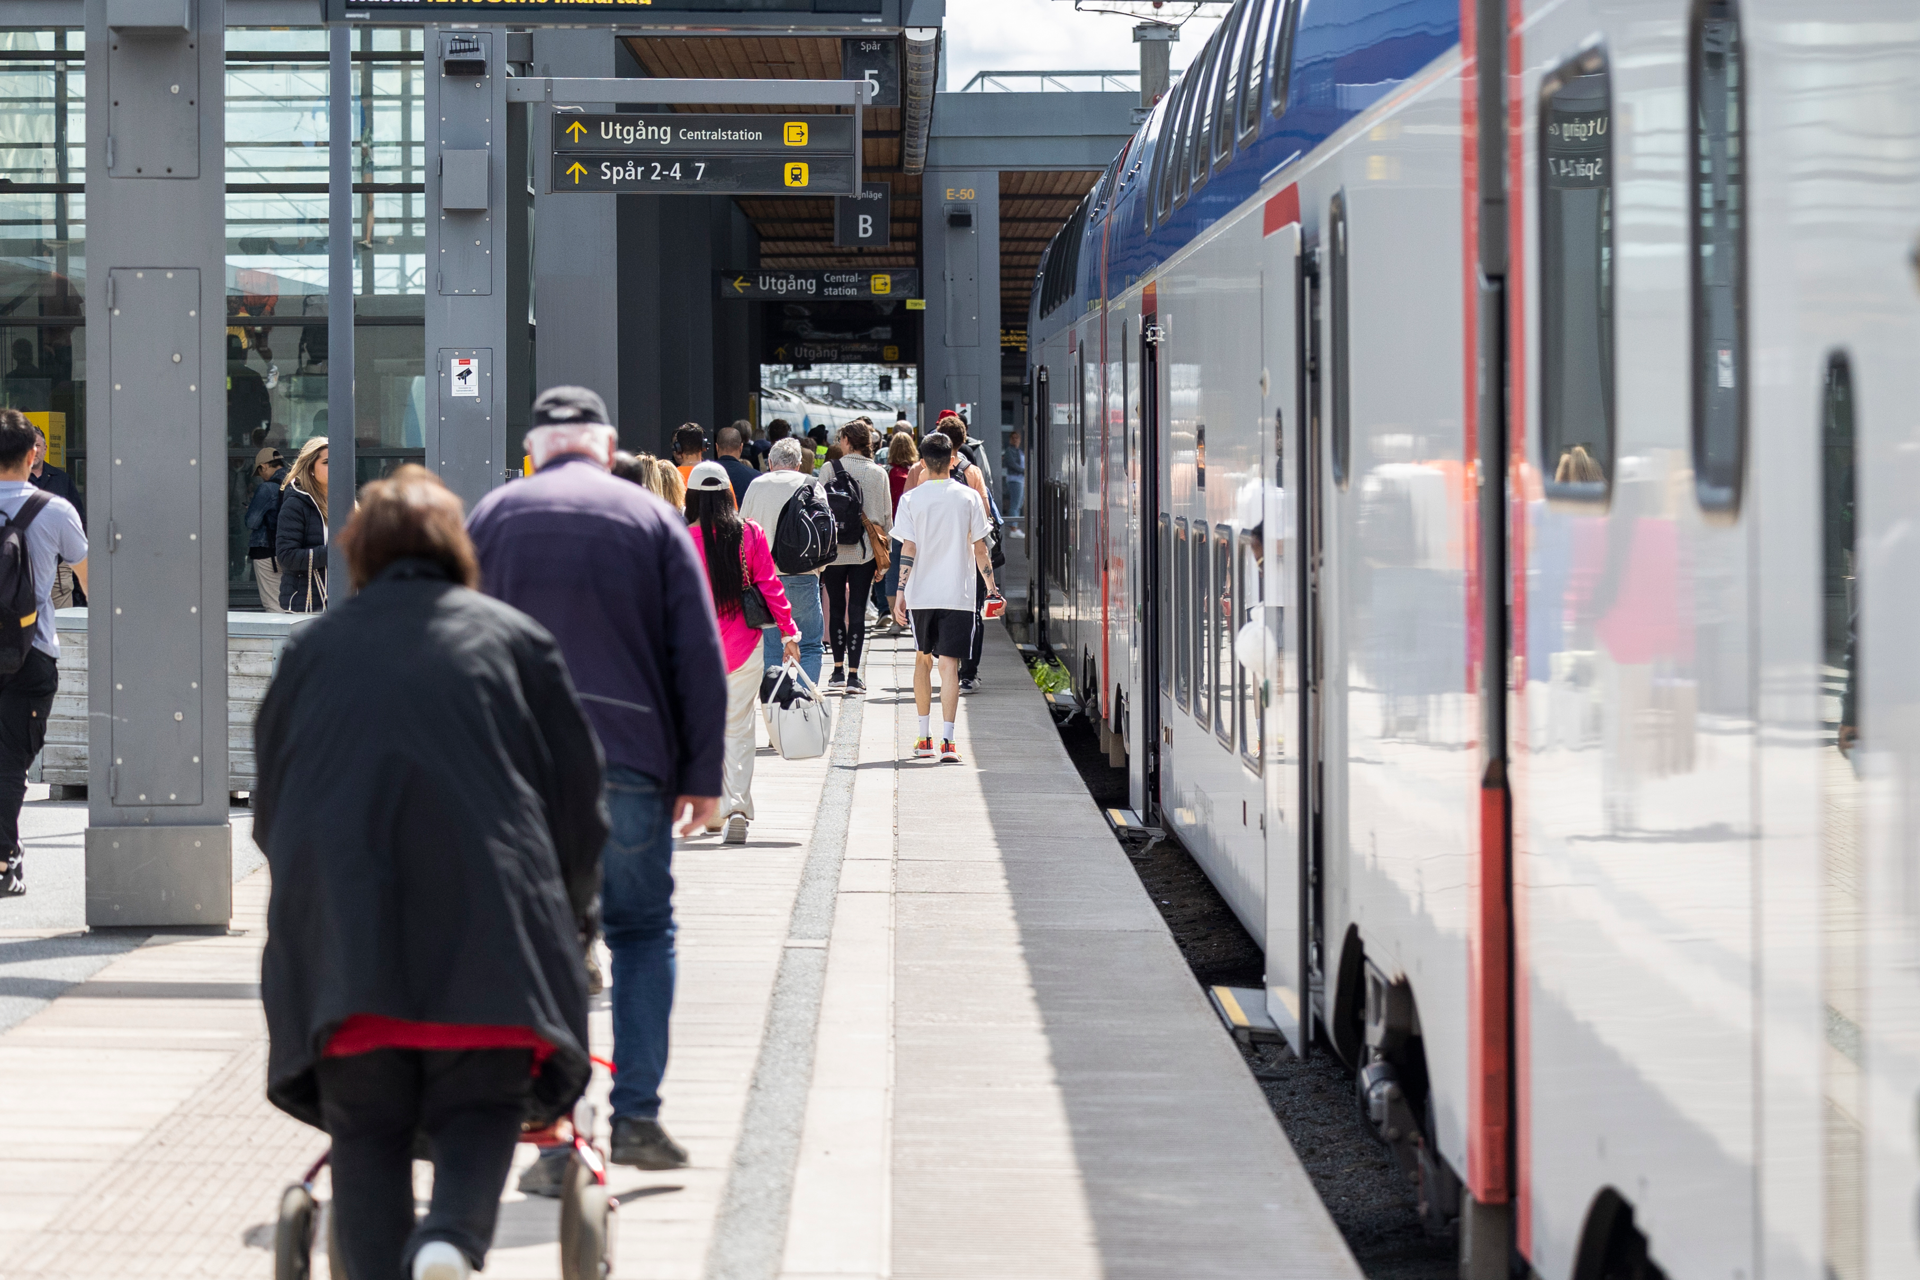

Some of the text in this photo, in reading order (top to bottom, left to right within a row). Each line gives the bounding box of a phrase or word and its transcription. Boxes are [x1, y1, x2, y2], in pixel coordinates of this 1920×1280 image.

[860, 41, 882, 53] Spår
[864, 69, 881, 97] 5
[600, 120, 763, 145] Utgång Centralstation
[600, 160, 706, 184] Spår 2-4 7
[946, 188, 975, 200] E-50
[858, 214, 873, 238] B
[759, 272, 862, 294] Utgång Central-
[823, 286, 858, 296] station
[794, 346, 838, 361] Utgång
